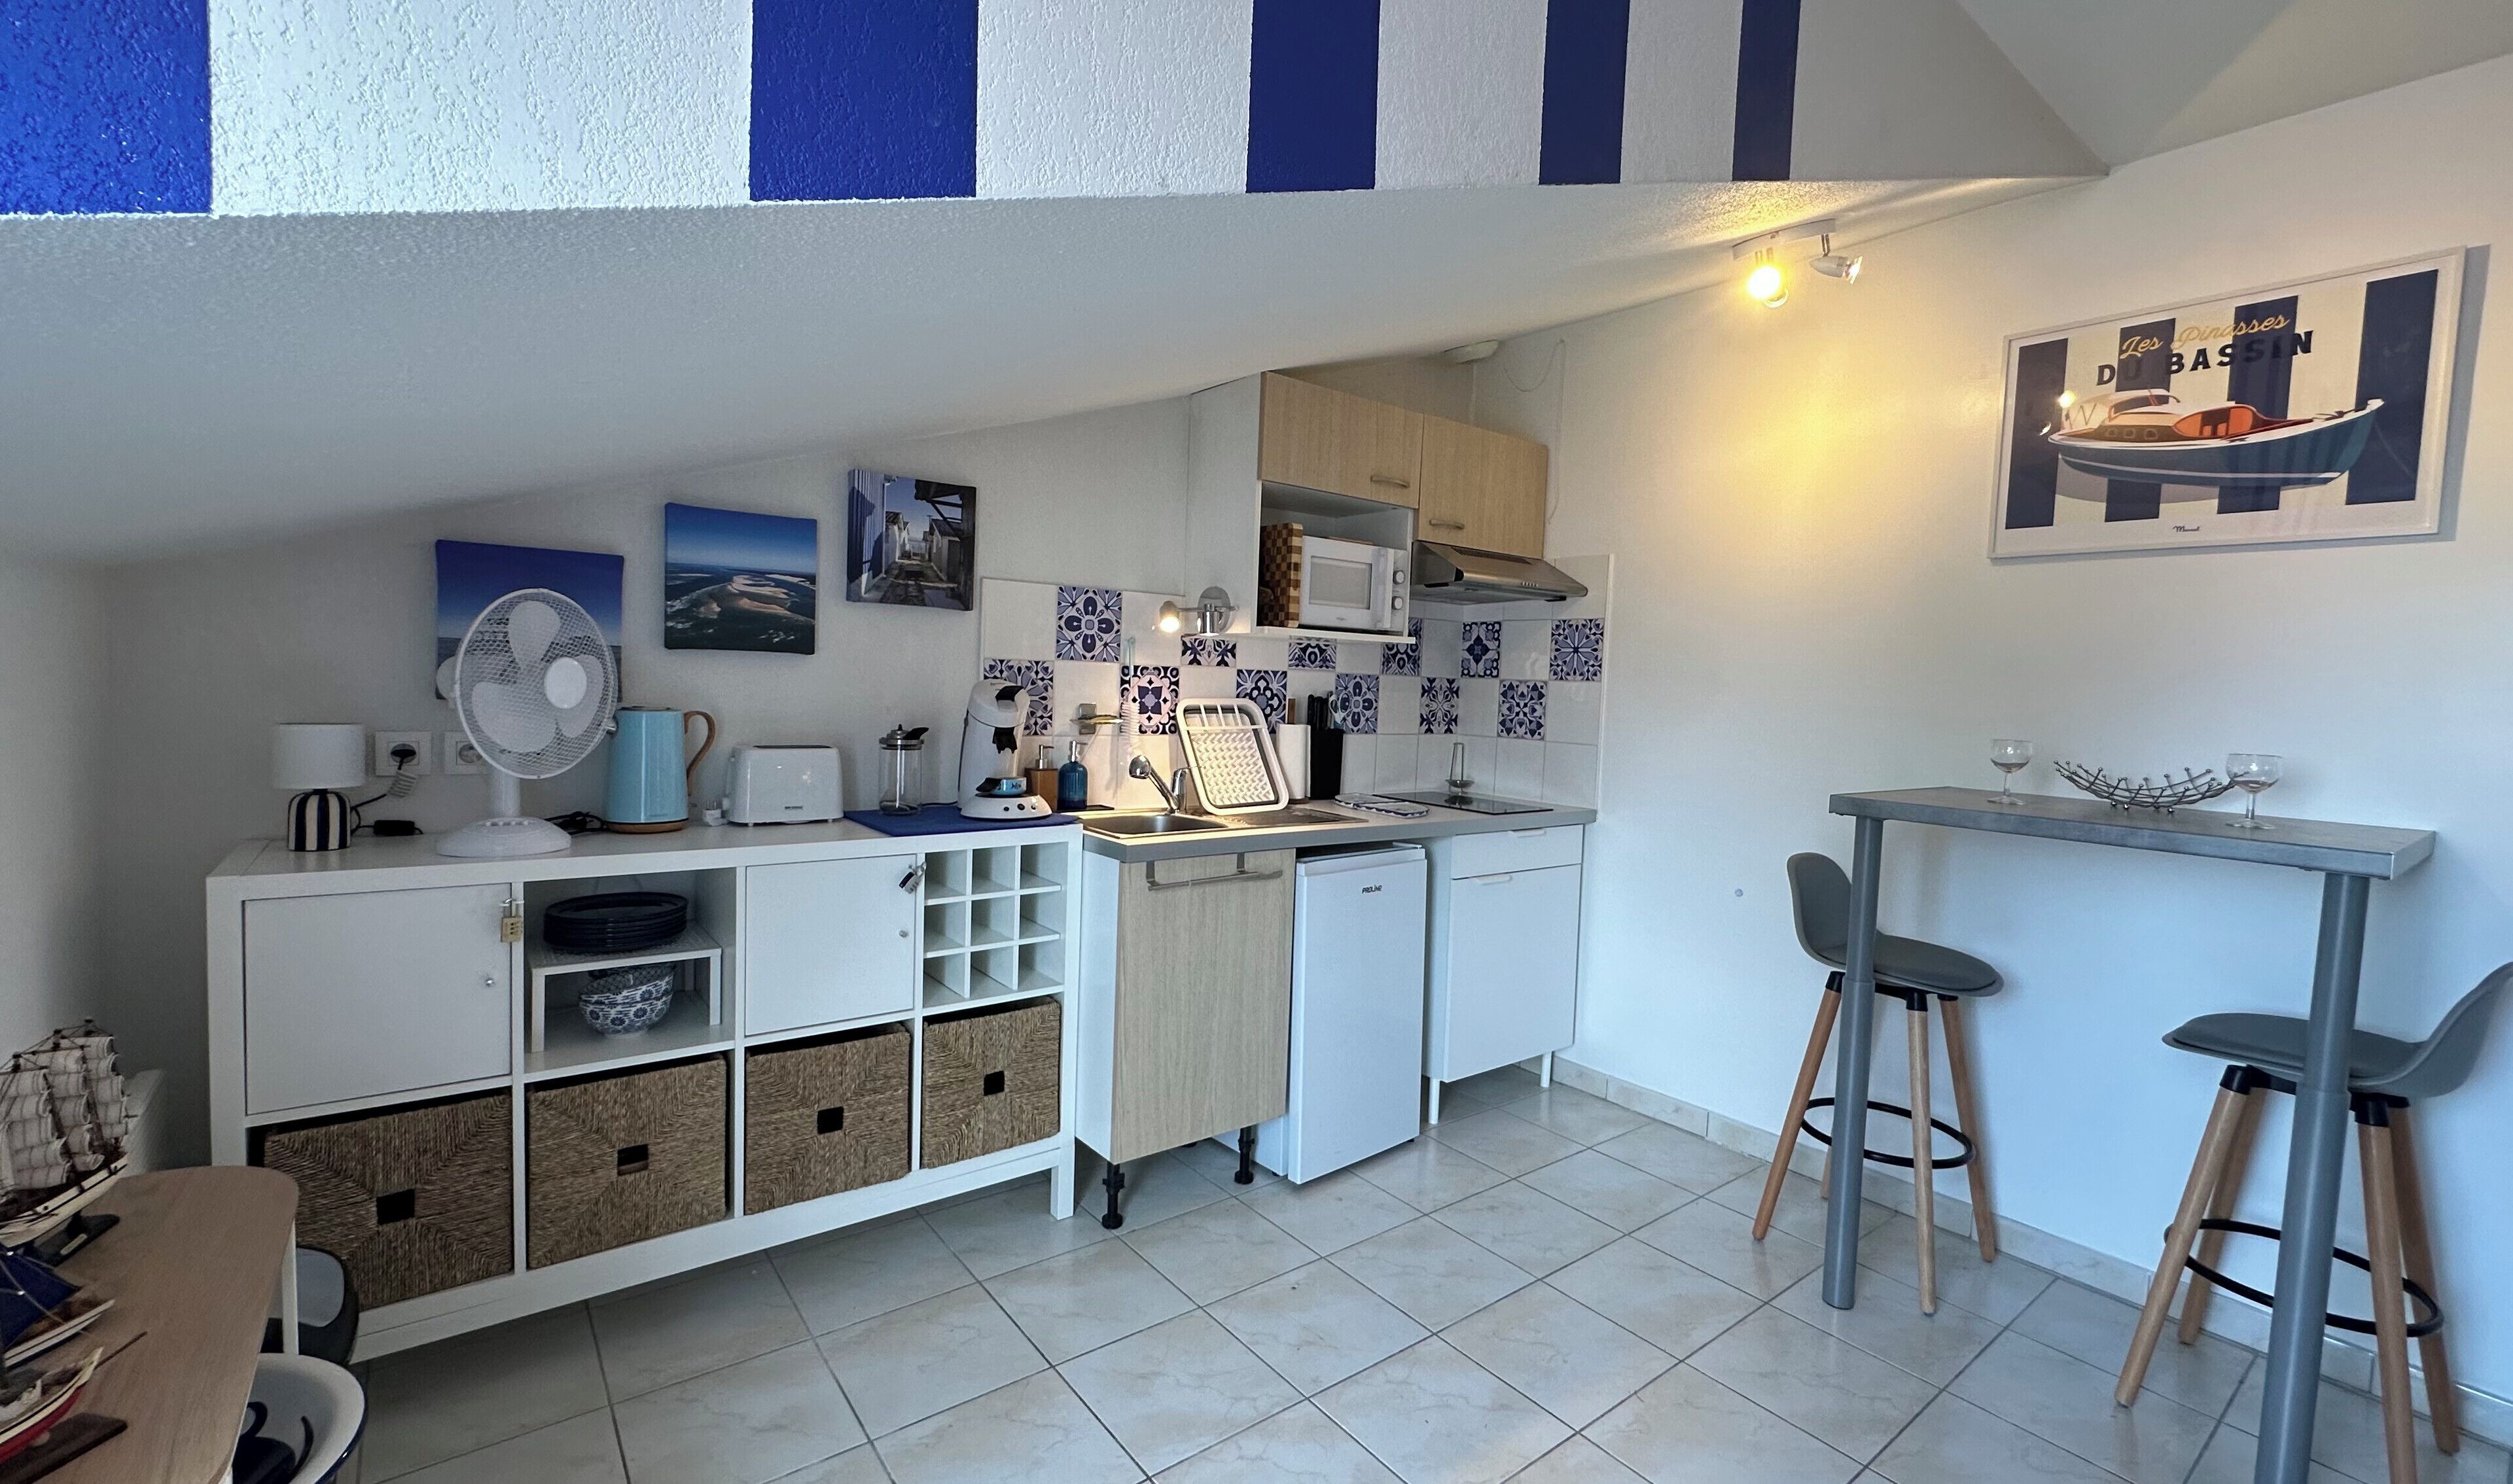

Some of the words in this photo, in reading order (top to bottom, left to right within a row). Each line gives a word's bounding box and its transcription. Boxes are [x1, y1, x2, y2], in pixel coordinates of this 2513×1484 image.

[2096, 360, 2144, 386] DU
[2165, 330, 2314, 378] BASSIN
[2119, 336, 2164, 359] Les
[2171, 314, 2290, 349] Pinasses
